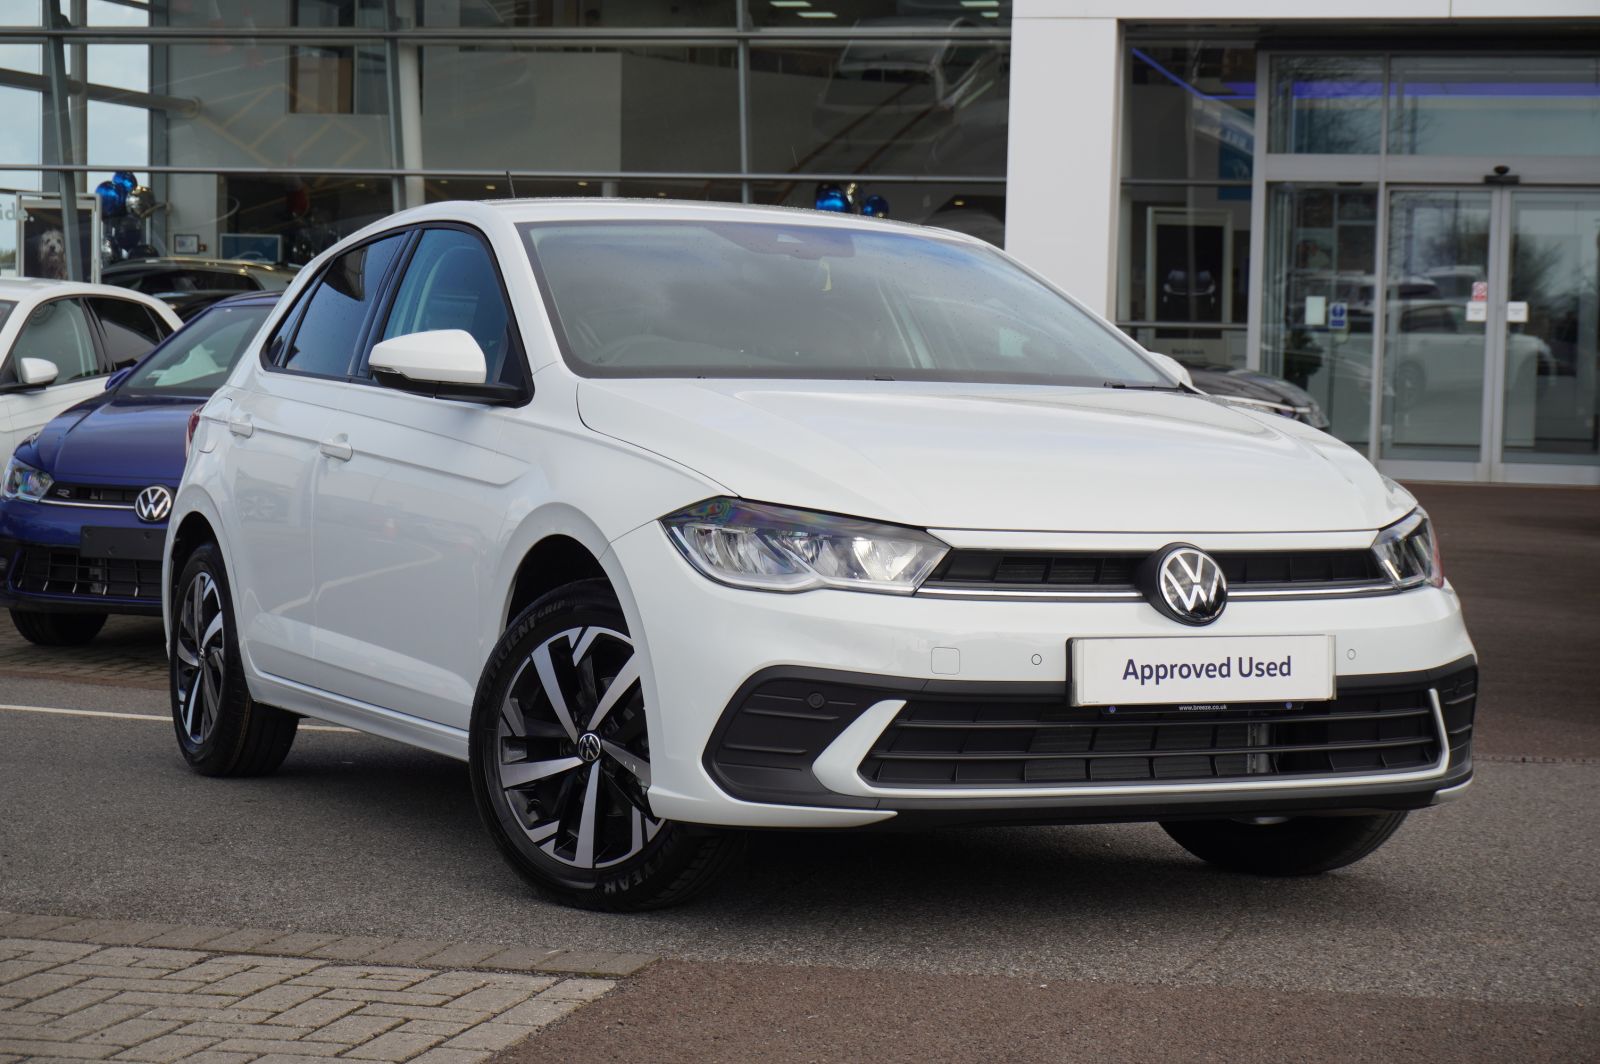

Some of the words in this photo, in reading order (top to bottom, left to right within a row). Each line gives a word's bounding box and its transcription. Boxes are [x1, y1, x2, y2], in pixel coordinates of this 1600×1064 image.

[1122, 656, 1232, 686] Approved
[1238, 655, 1292, 678] Used
[1178, 704, 1228, 712] www.breeze.co.uk
